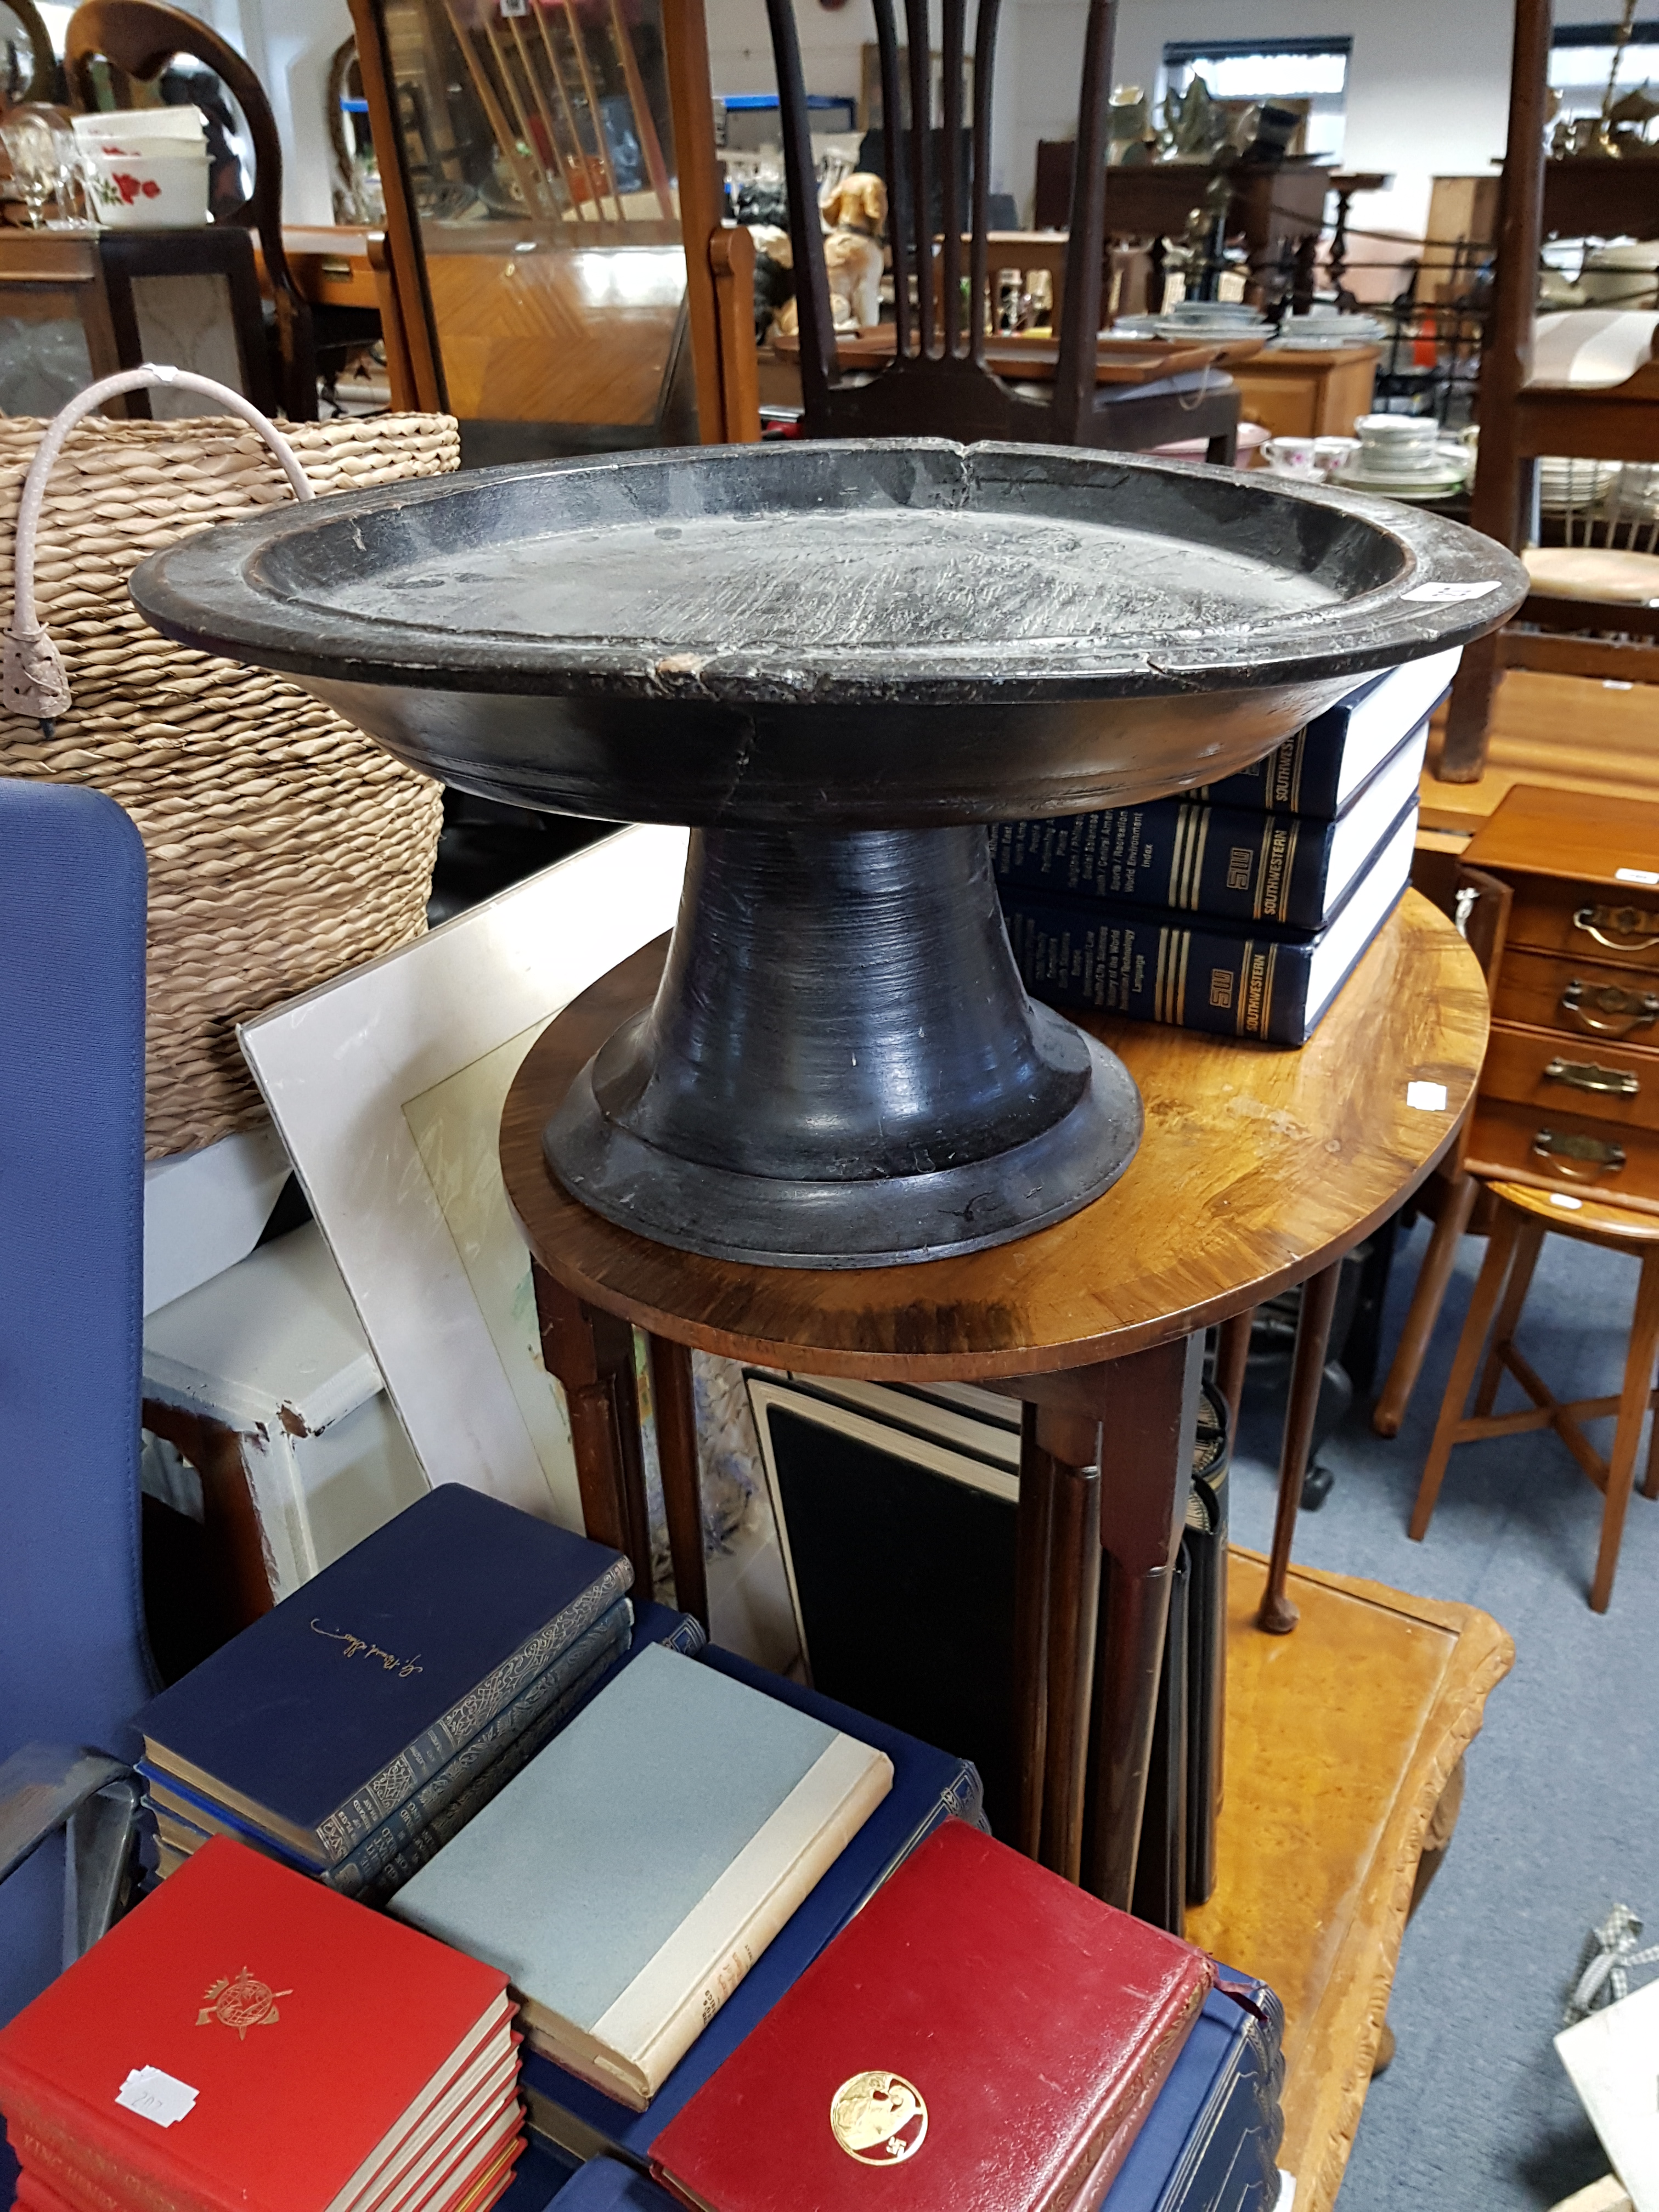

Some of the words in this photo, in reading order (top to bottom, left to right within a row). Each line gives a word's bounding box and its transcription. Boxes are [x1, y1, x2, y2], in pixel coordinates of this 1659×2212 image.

[1113, 811, 1128, 857] Recreation
[1127, 812, 1143, 867] Environment
[1141, 843, 1153, 868] Index
[1264, 830, 1288, 916] SOUTHWESTERN
[1110, 865, 1122, 891] Sports
[1125, 868, 1137, 893] World
[1109, 929, 1121, 953] World
[1132, 954, 1146, 994] Language
[1246, 953, 1266, 1032] SOUTHWESTERN
